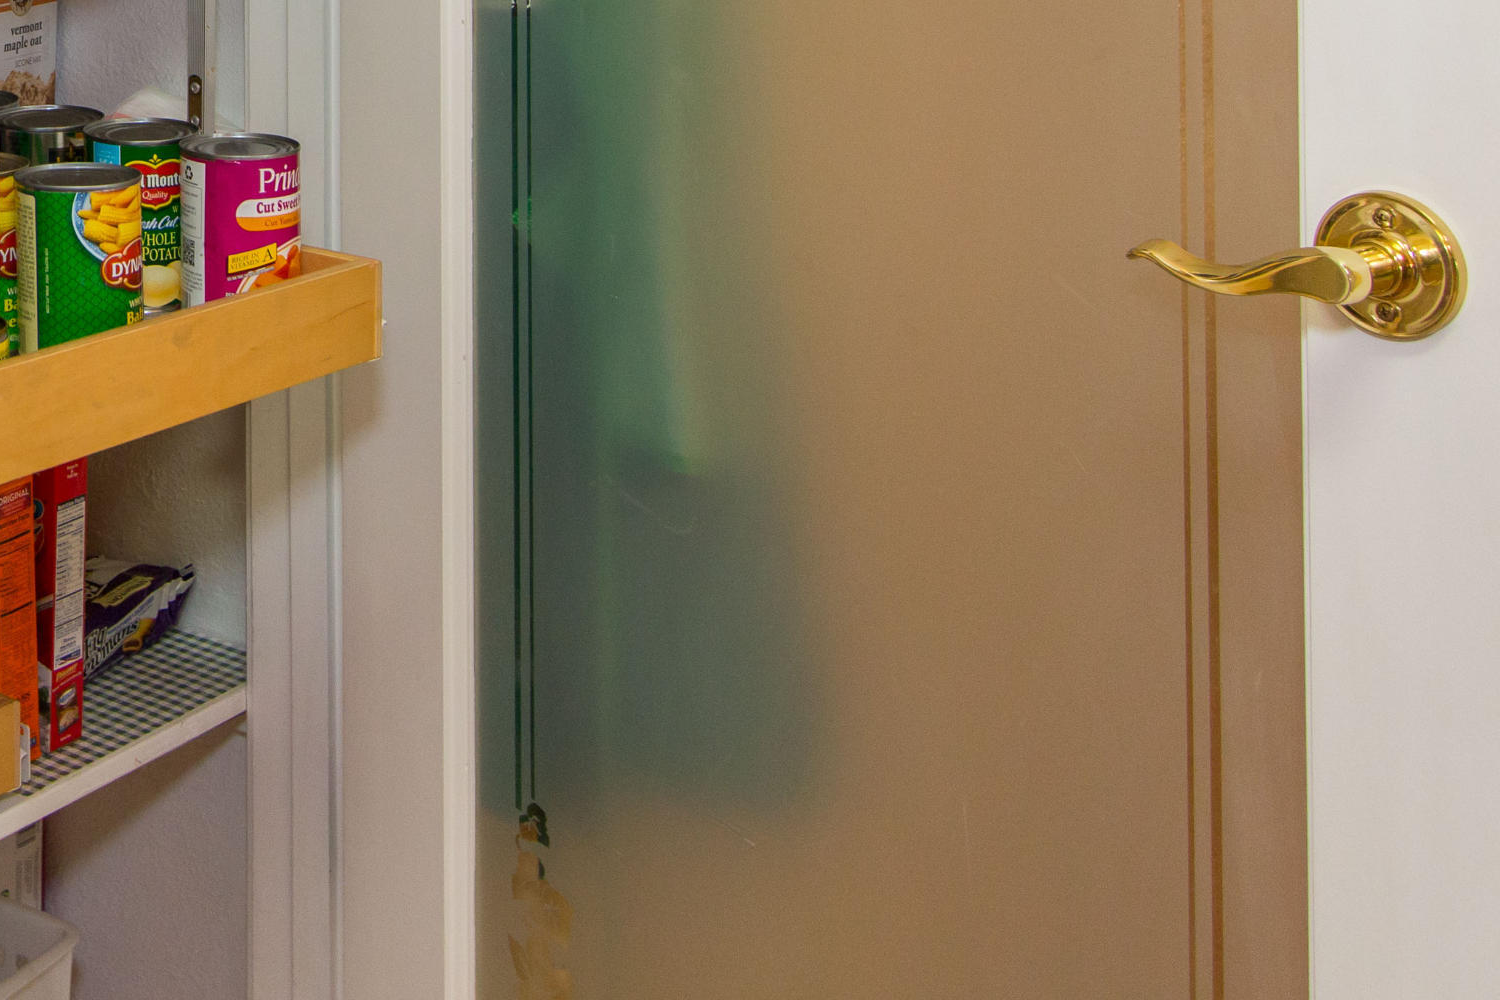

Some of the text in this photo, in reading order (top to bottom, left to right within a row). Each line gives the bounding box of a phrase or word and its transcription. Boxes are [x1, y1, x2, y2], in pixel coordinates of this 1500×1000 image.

[10, 20, 43, 37] vermont
[3, 36, 43, 55] maple oat
[141, 191, 169, 202] Quality
[256, 201, 275, 214] Cut
[158, 215, 179, 229] Cut
[229, 247, 274, 272] VITAMIN A
[232, 252, 251, 263] RICH
[110, 257, 142, 279] DYNA
